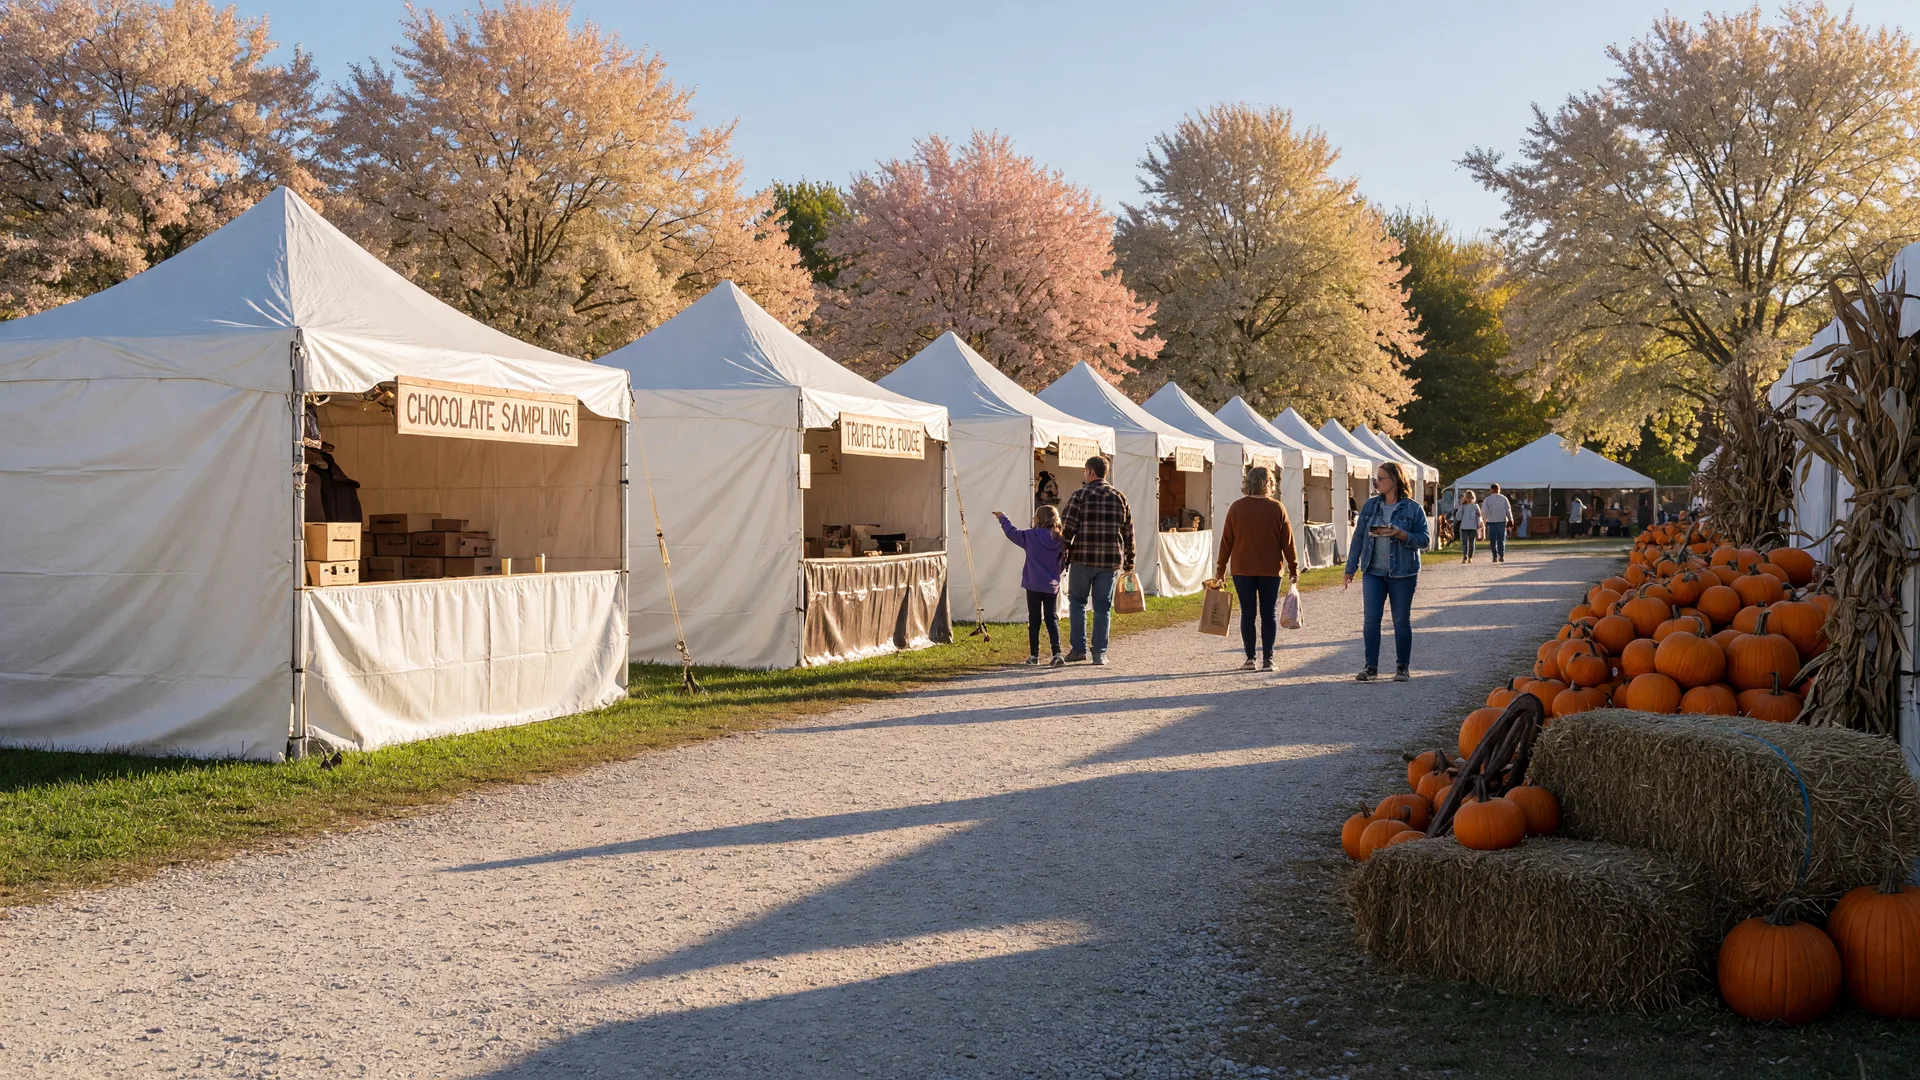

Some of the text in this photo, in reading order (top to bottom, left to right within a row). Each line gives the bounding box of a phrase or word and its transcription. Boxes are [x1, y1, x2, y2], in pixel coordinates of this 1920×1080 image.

[407, 392, 570, 437] CHOCOLATE SAMPLING
[845, 420, 887, 450] TRUFFLES
[888, 427, 895, 450] &
